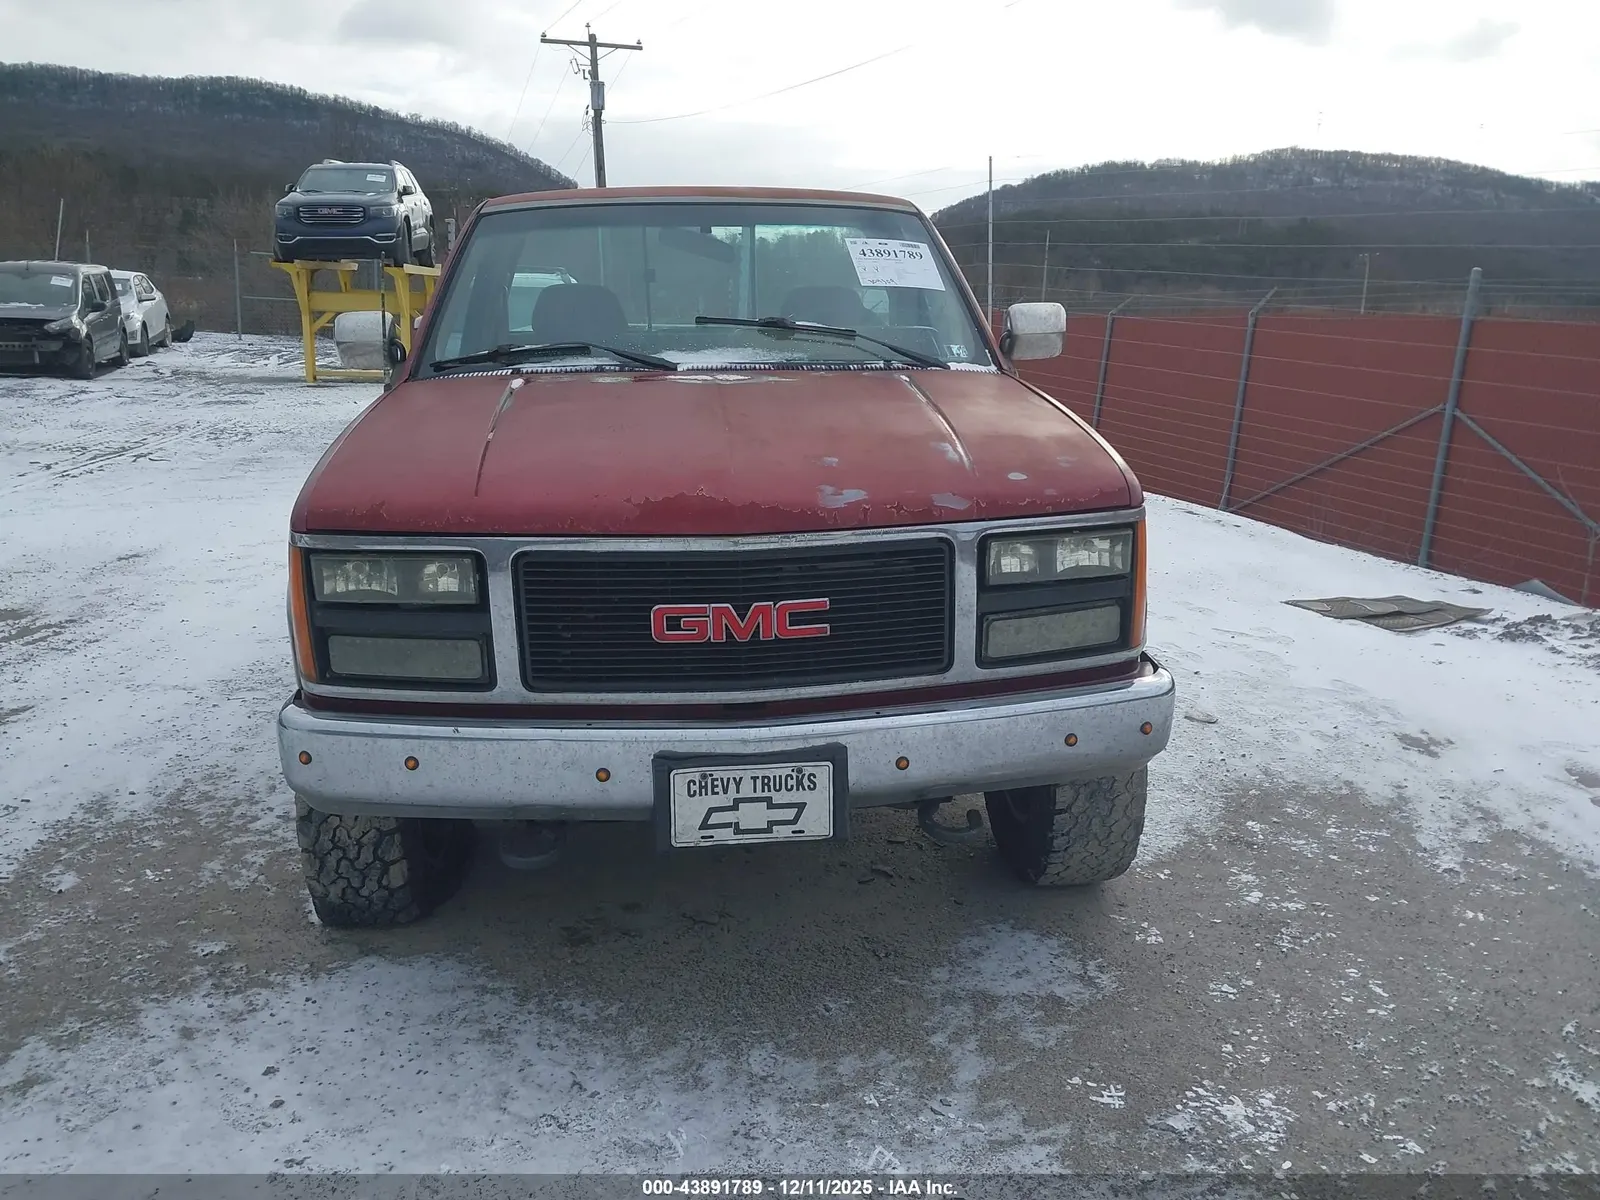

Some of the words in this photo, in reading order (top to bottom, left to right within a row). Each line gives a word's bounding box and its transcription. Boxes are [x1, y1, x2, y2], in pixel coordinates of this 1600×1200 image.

[317, 207, 344, 215] GMC
[859, 248, 923, 260] 43891789
[651, 597, 831, 643] GMC
[686, 776, 744, 798] CHEVY
[750, 772, 817, 793] TRUCKS
